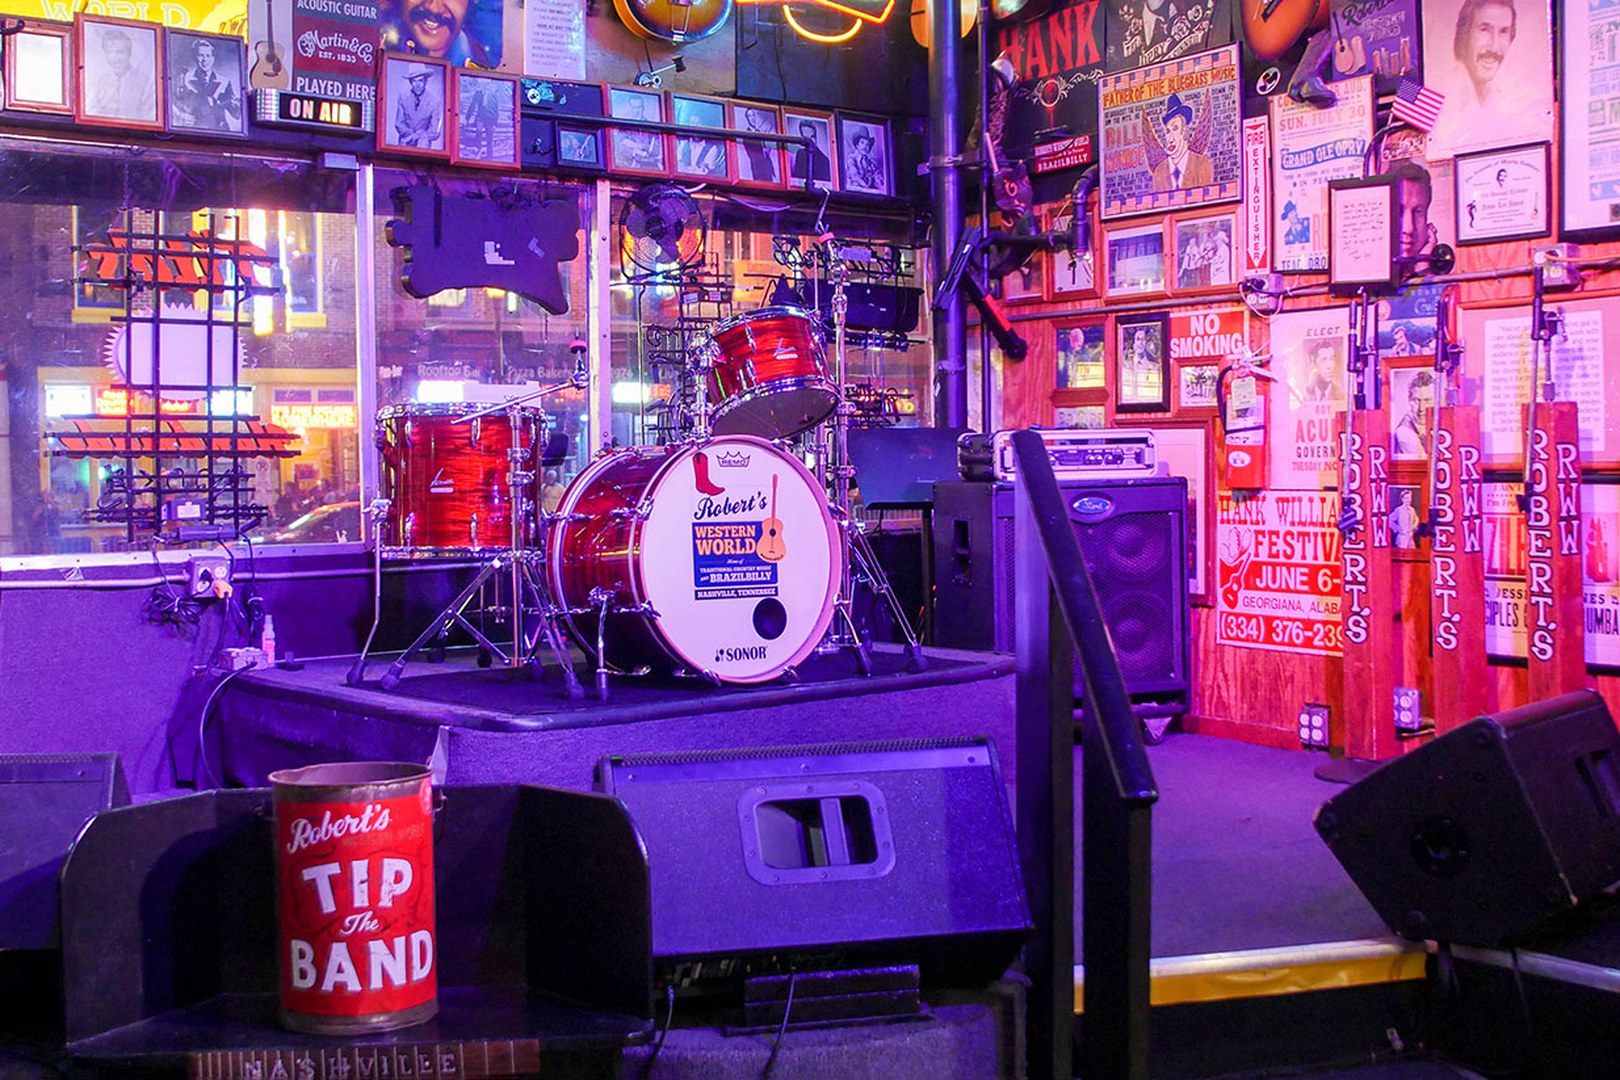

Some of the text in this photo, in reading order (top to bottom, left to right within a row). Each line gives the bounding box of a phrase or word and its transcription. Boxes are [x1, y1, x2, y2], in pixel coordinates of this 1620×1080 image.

[297, 0, 377, 19] ACOUSTIC GUITAR
[1001, 2, 1100, 82] HANK
[297, 77, 376, 101] PLAYED HERE
[1147, 81, 1166, 97] THE
[1167, 71, 1209, 93] BLUEGRASS
[290, 98, 352, 125] ON AIR
[1280, 105, 1366, 131] SUN. JULY 30
[1247, 131, 1264, 146] FIRE
[1283, 150, 1315, 169] GRAND
[1316, 145, 1335, 162] OLE
[1335, 139, 1364, 157] OPRY
[1190, 314, 1220, 336] NO
[1306, 326, 1342, 337] ELECT
[1171, 333, 1244, 358] SMOKING
[417, 365, 461, 378] Rooftop
[1296, 446, 1337, 459] GOVERN
[694, 491, 767, 520] Robert's
[1219, 495, 1338, 528] HANK WILLIA
[694, 525, 756, 538] WESTERN
[696, 538, 757, 556] WORLD
[710, 571, 772, 583] BRAZILBILLY
[1255, 565, 1310, 591] JUNE
[697, 590, 737, 598] NASHVILLE,
[1242, 595, 1304, 613] GEORGIANA,
[1220, 613, 1264, 642] (334)
[726, 646, 768, 662] SONOR
[286, 804, 392, 854] Robert's
[302, 857, 414, 915] TIP
[340, 910, 380, 937] The
[290, 930, 434, 992] BAND
